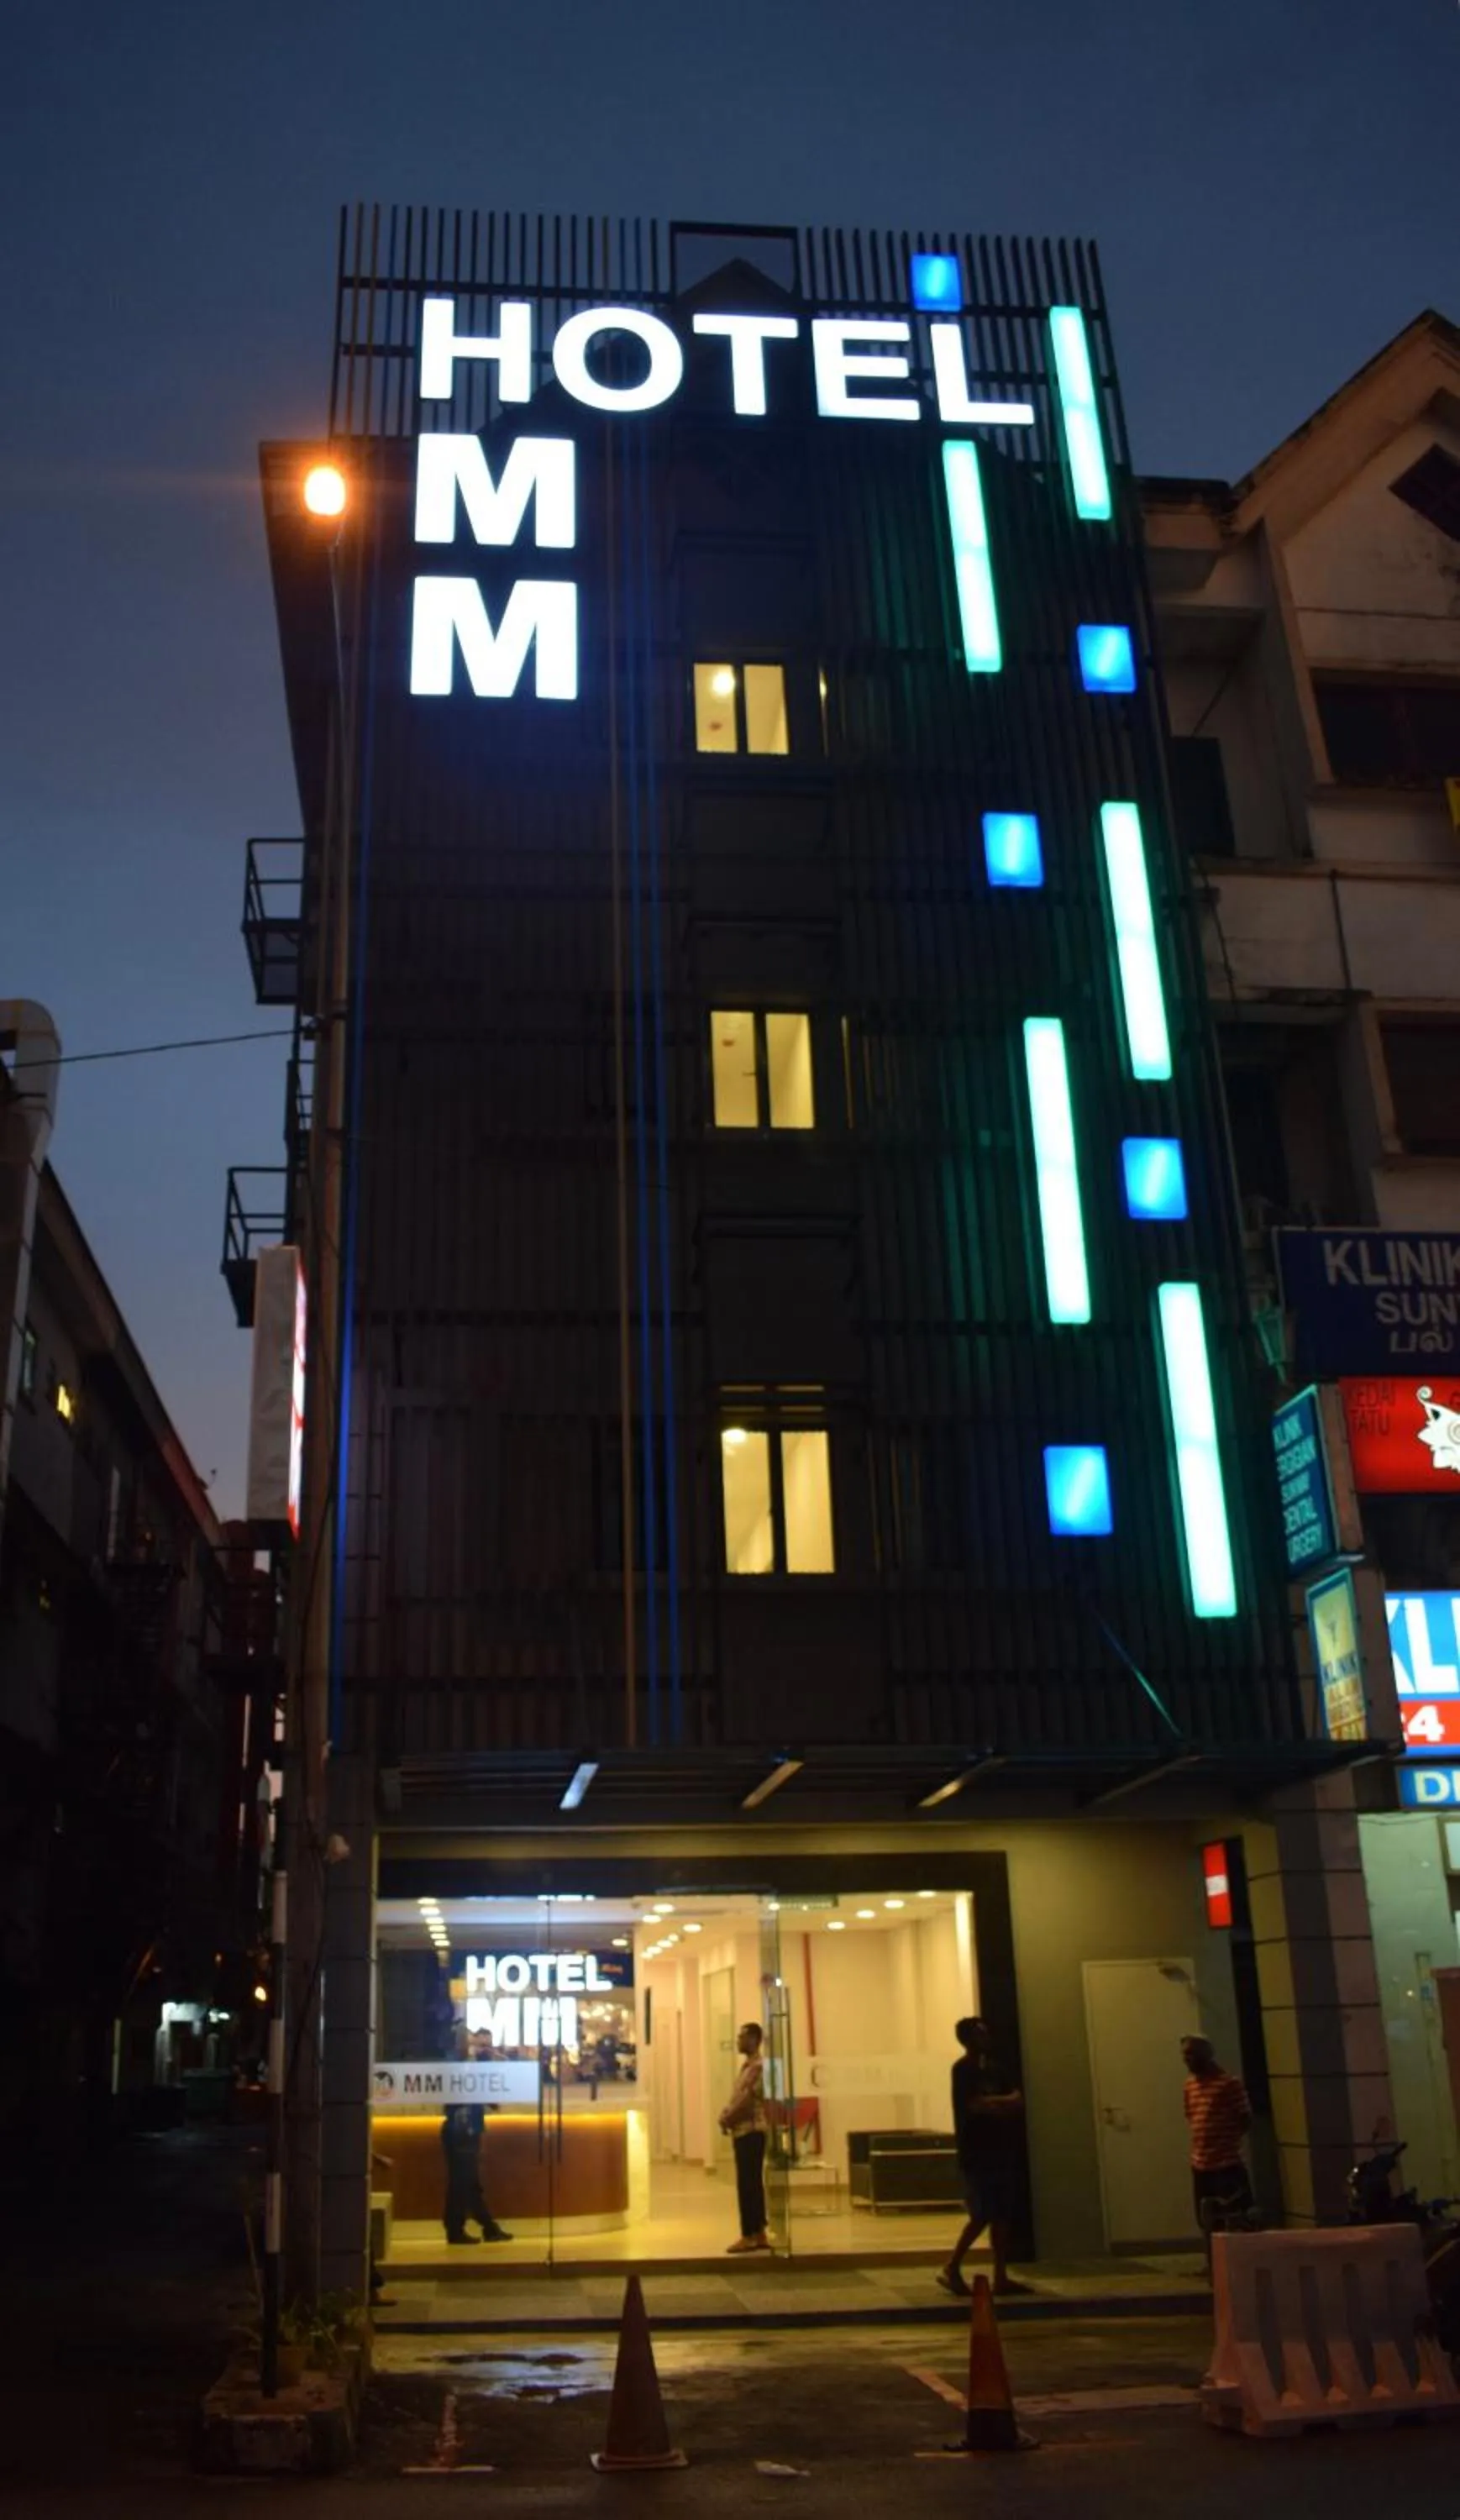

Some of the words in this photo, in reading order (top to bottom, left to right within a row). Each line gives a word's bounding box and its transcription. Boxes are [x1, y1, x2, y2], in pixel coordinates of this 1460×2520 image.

[420, 298, 1034, 425] HOTEL
[1375, 1291, 1460, 1326] SUN
[466, 1955, 612, 1992] HOTEL
[404, 2074, 443, 2093] MM
[449, 2073, 511, 2092] HOTEL
